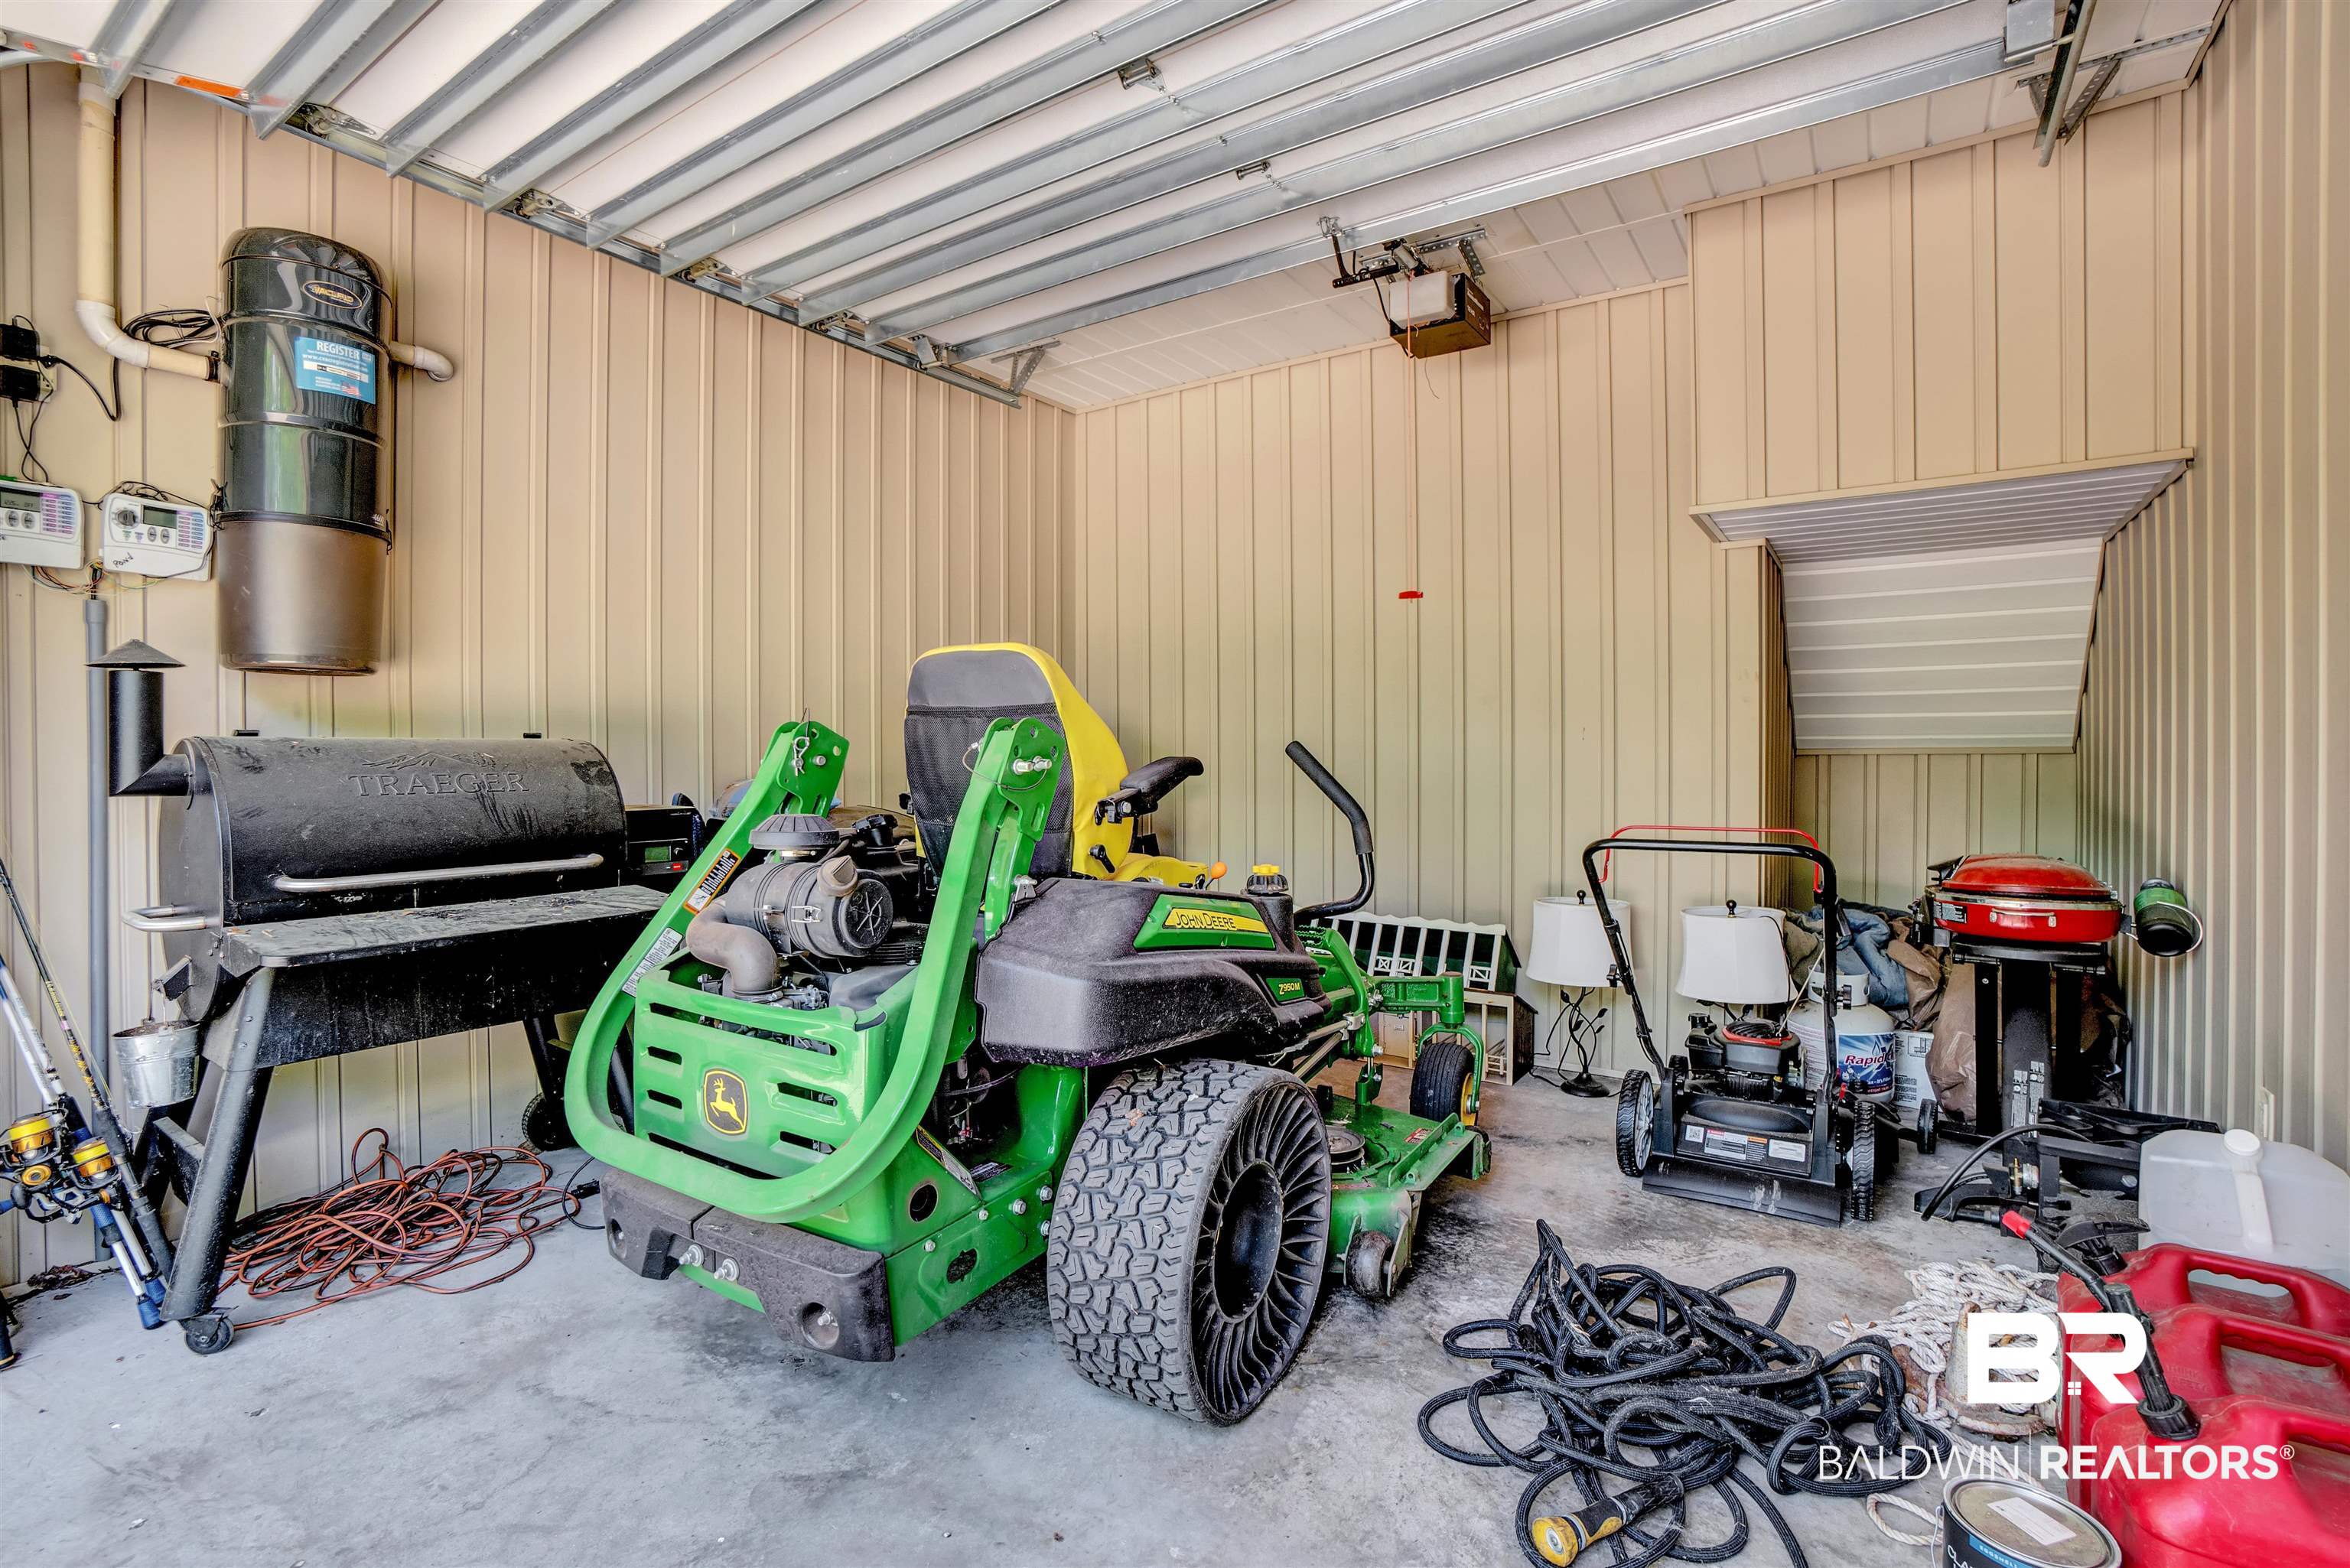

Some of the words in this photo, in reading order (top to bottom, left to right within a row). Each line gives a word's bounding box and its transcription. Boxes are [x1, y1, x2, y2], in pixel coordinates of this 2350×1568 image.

[316, 340, 360, 360] REGISTER
[348, 771, 529, 796] TRAEGER
[1176, 911, 1203, 926] JOHN
[1203, 912, 1237, 929] DEERE
[1278, 982, 1300, 995] Z950M
[1844, 1052, 1886, 1069] Rapid
